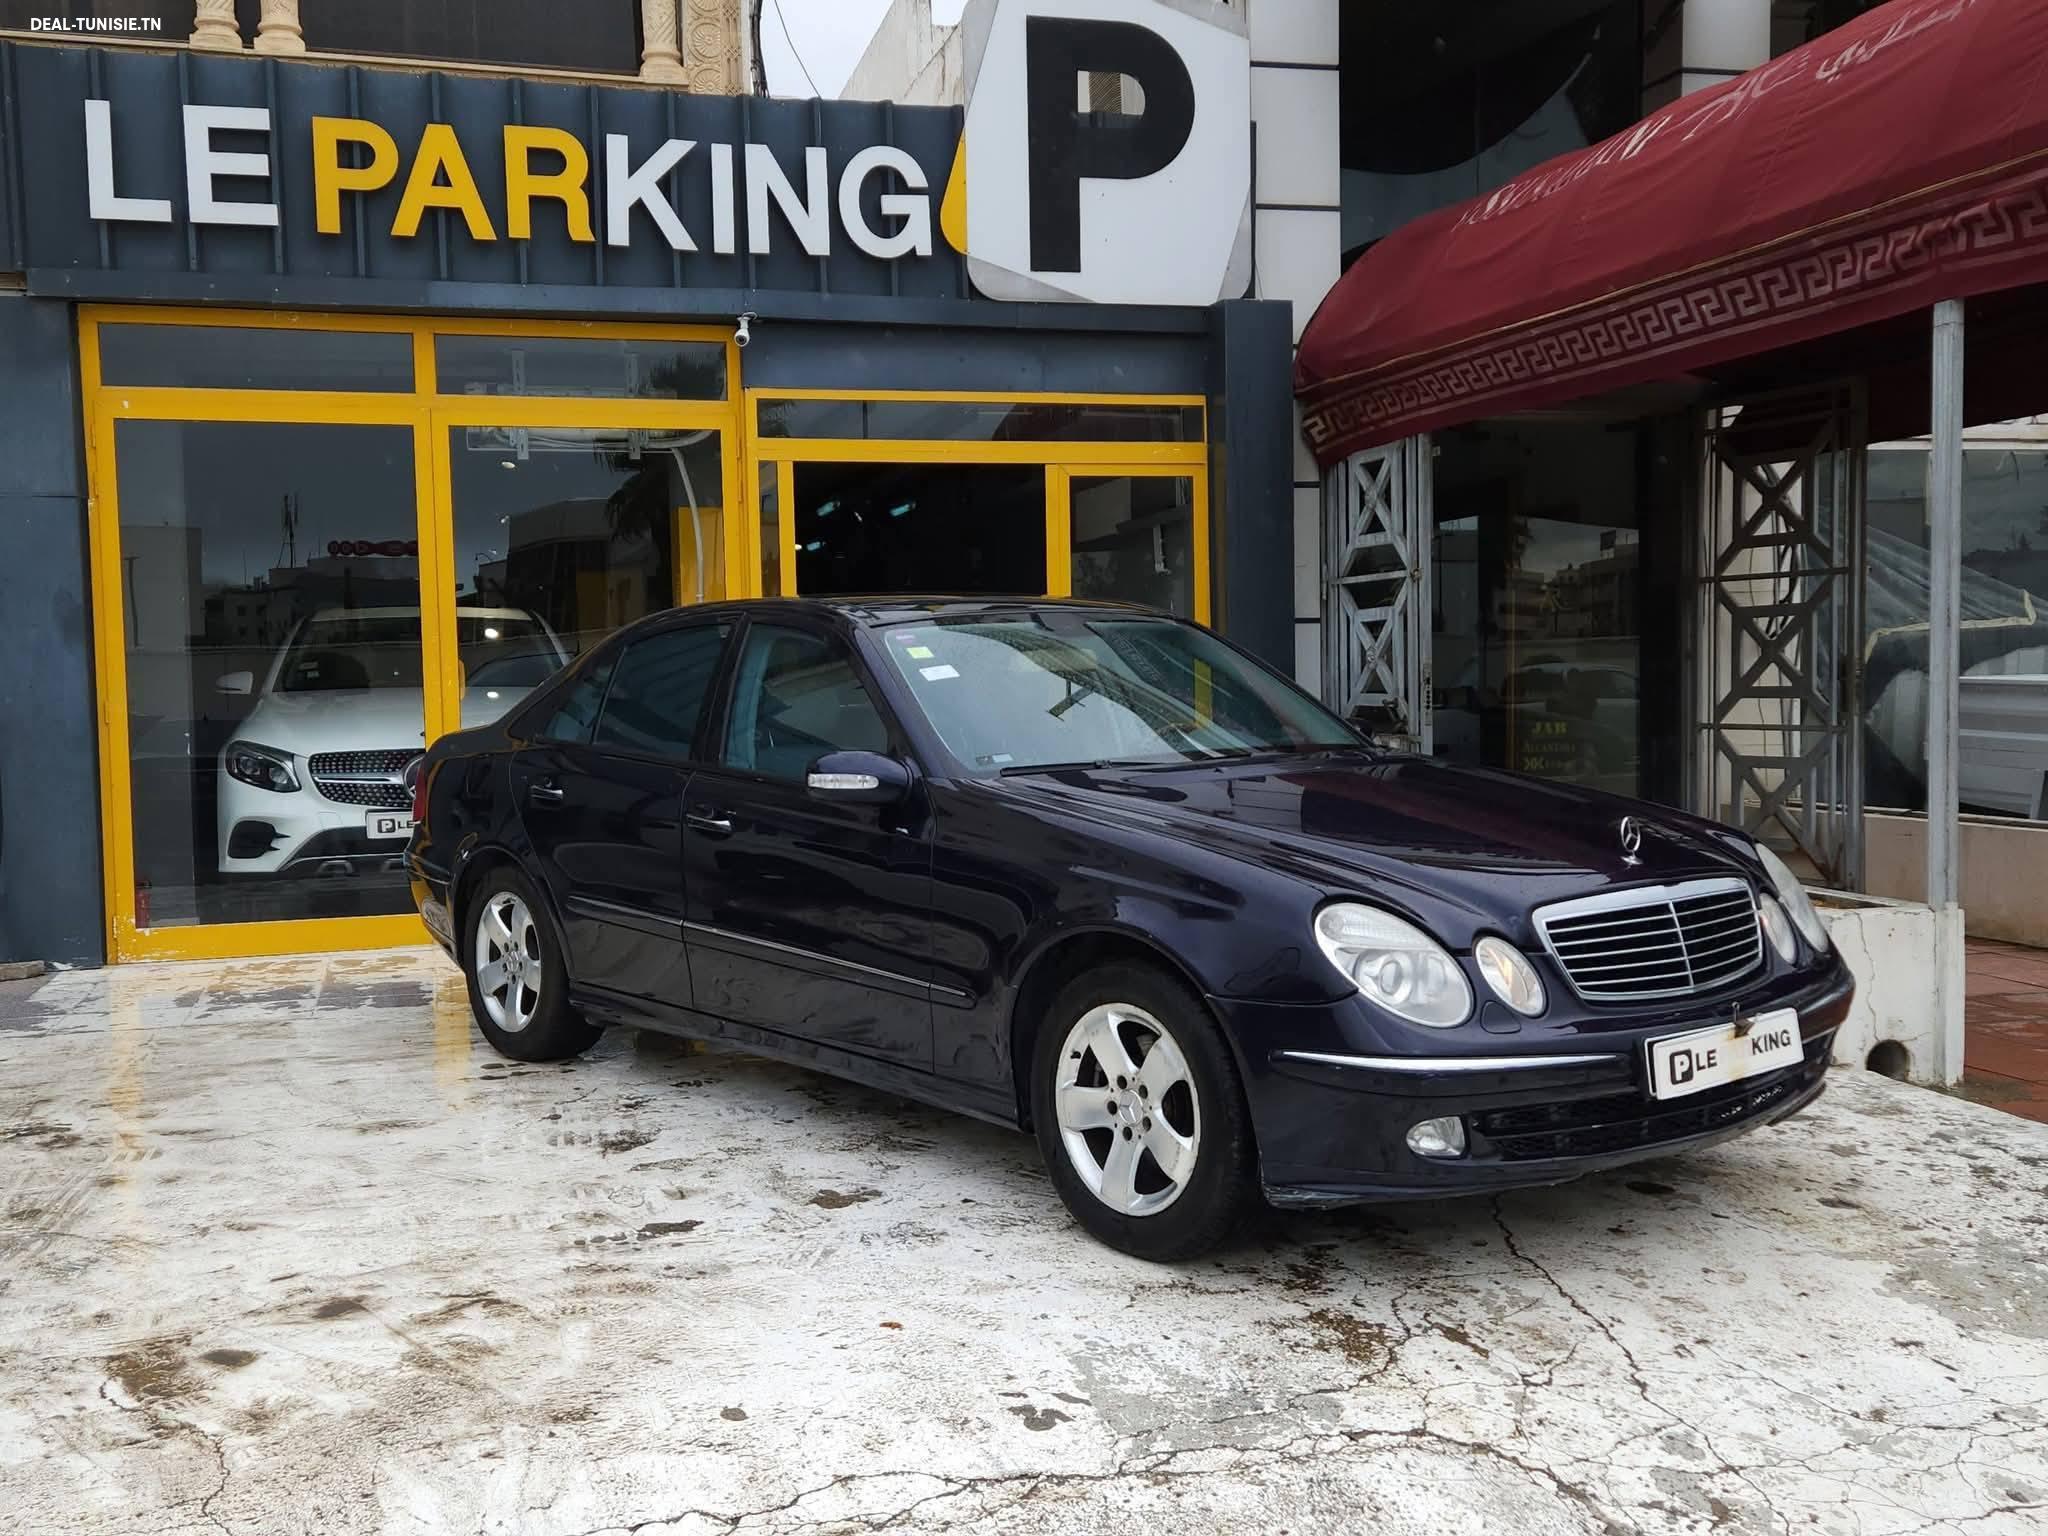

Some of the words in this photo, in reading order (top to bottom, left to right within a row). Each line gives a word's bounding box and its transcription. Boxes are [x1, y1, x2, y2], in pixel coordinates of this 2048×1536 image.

[85, 99, 279, 226] LE
[312, 116, 932, 259] PARKING
[1026, 15, 1195, 272] P
[1695, 1049, 1718, 1072] LE
[1752, 1029, 1791, 1055] KING
